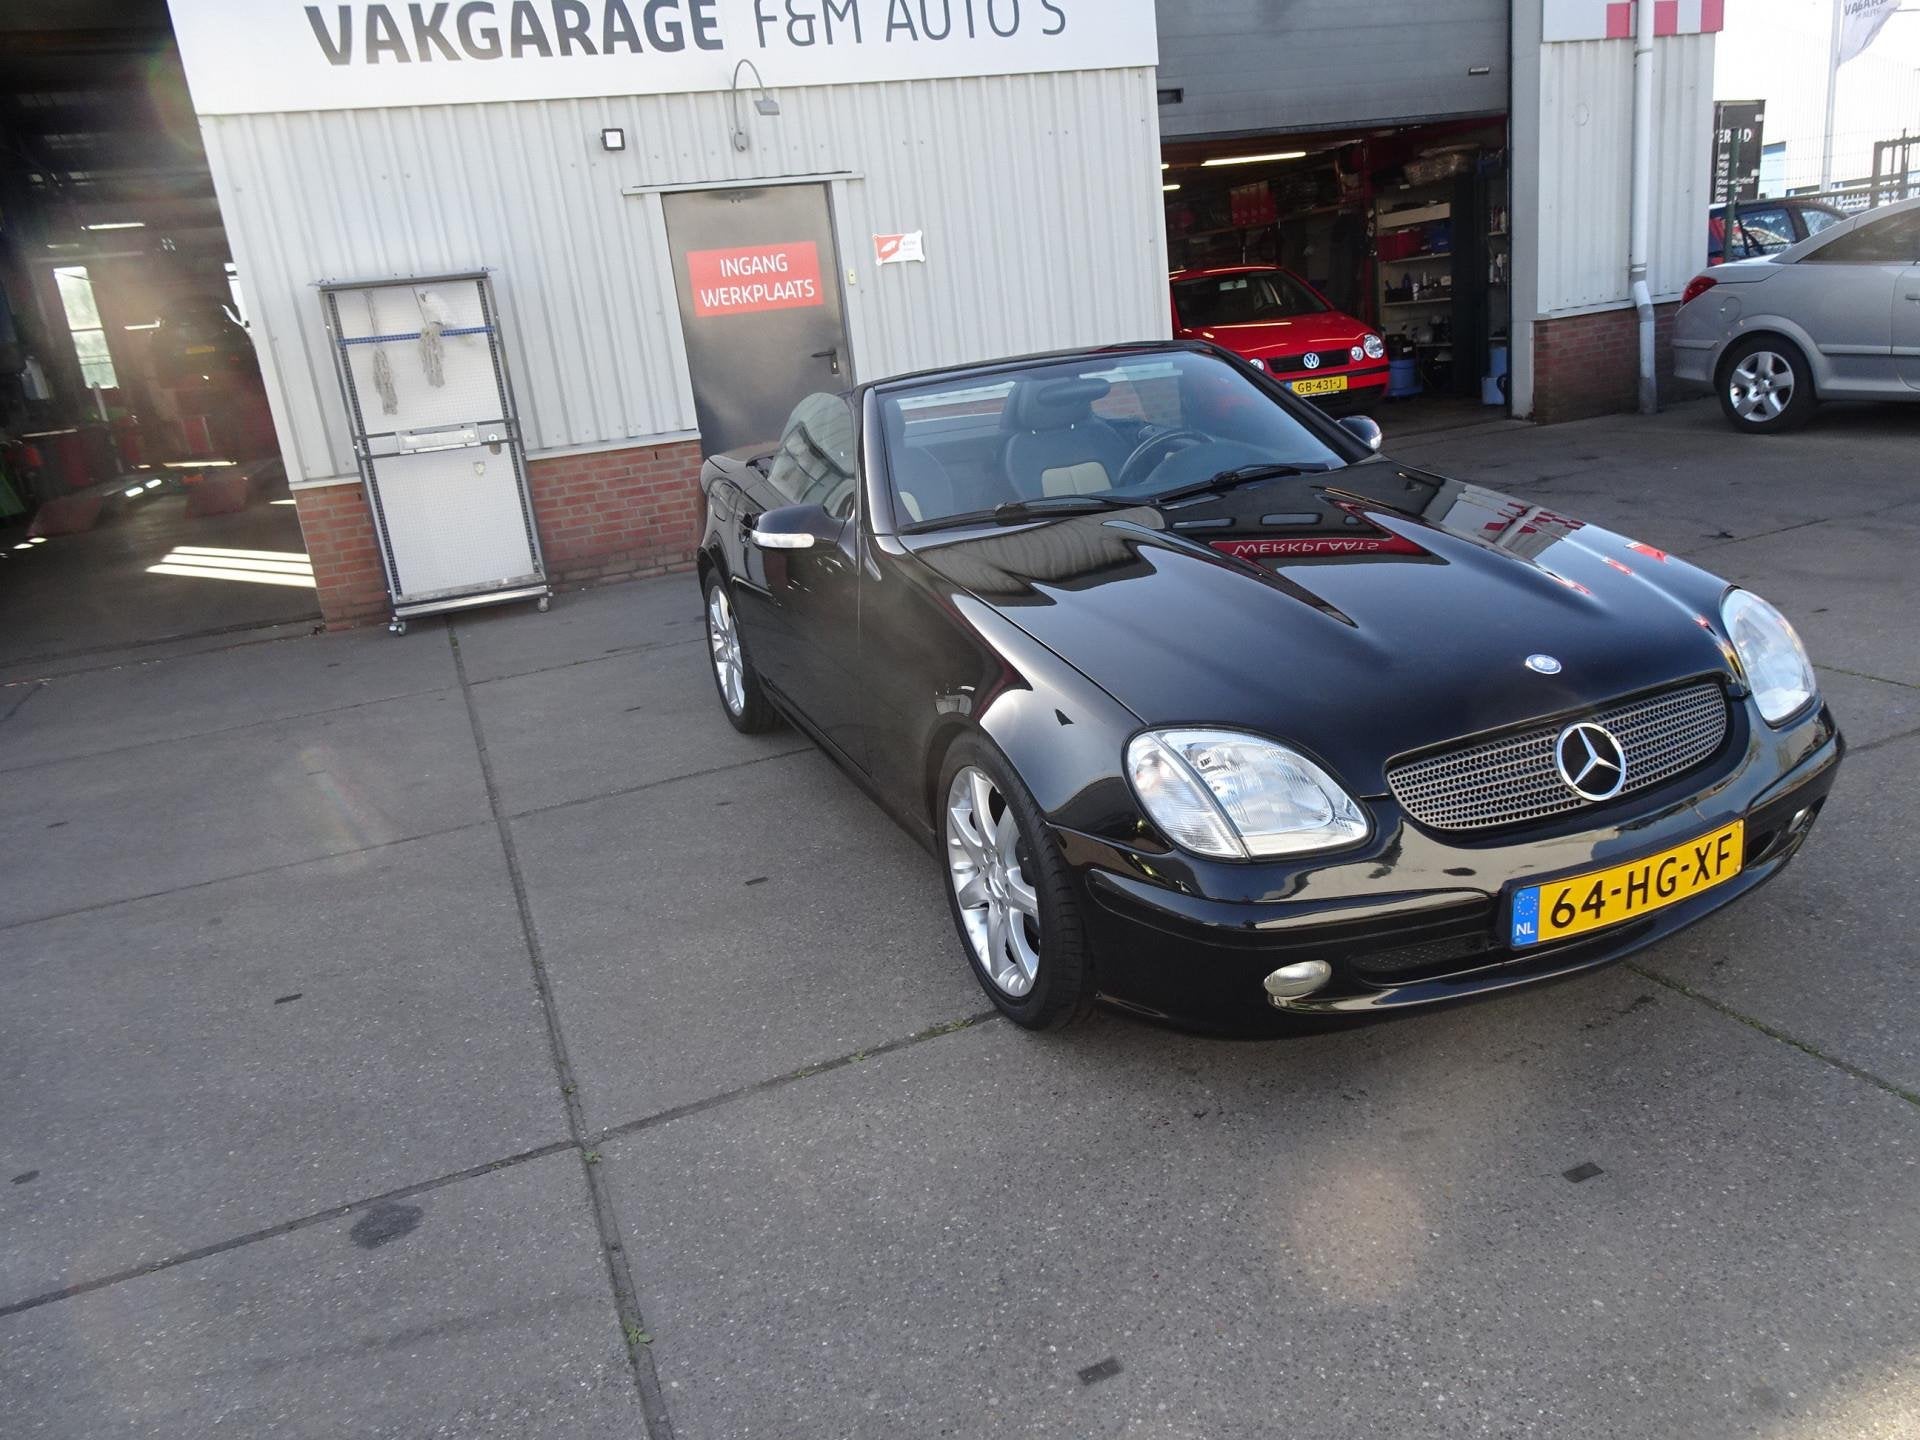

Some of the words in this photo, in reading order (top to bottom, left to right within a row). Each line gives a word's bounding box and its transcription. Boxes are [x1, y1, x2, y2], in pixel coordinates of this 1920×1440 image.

[304, 0, 724, 67] VAKGARAGE
[754, 0, 862, 49] F&M
[885, 0, 1066, 43] AUTOS
[720, 253, 788, 278] INGANG
[700, 279, 815, 308] WERKPLAATS
[1297, 378, 1342, 393] GB-431-J
[1516, 921, 1534, 936] NL
[1550, 832, 1732, 929] 64-HG-XF
